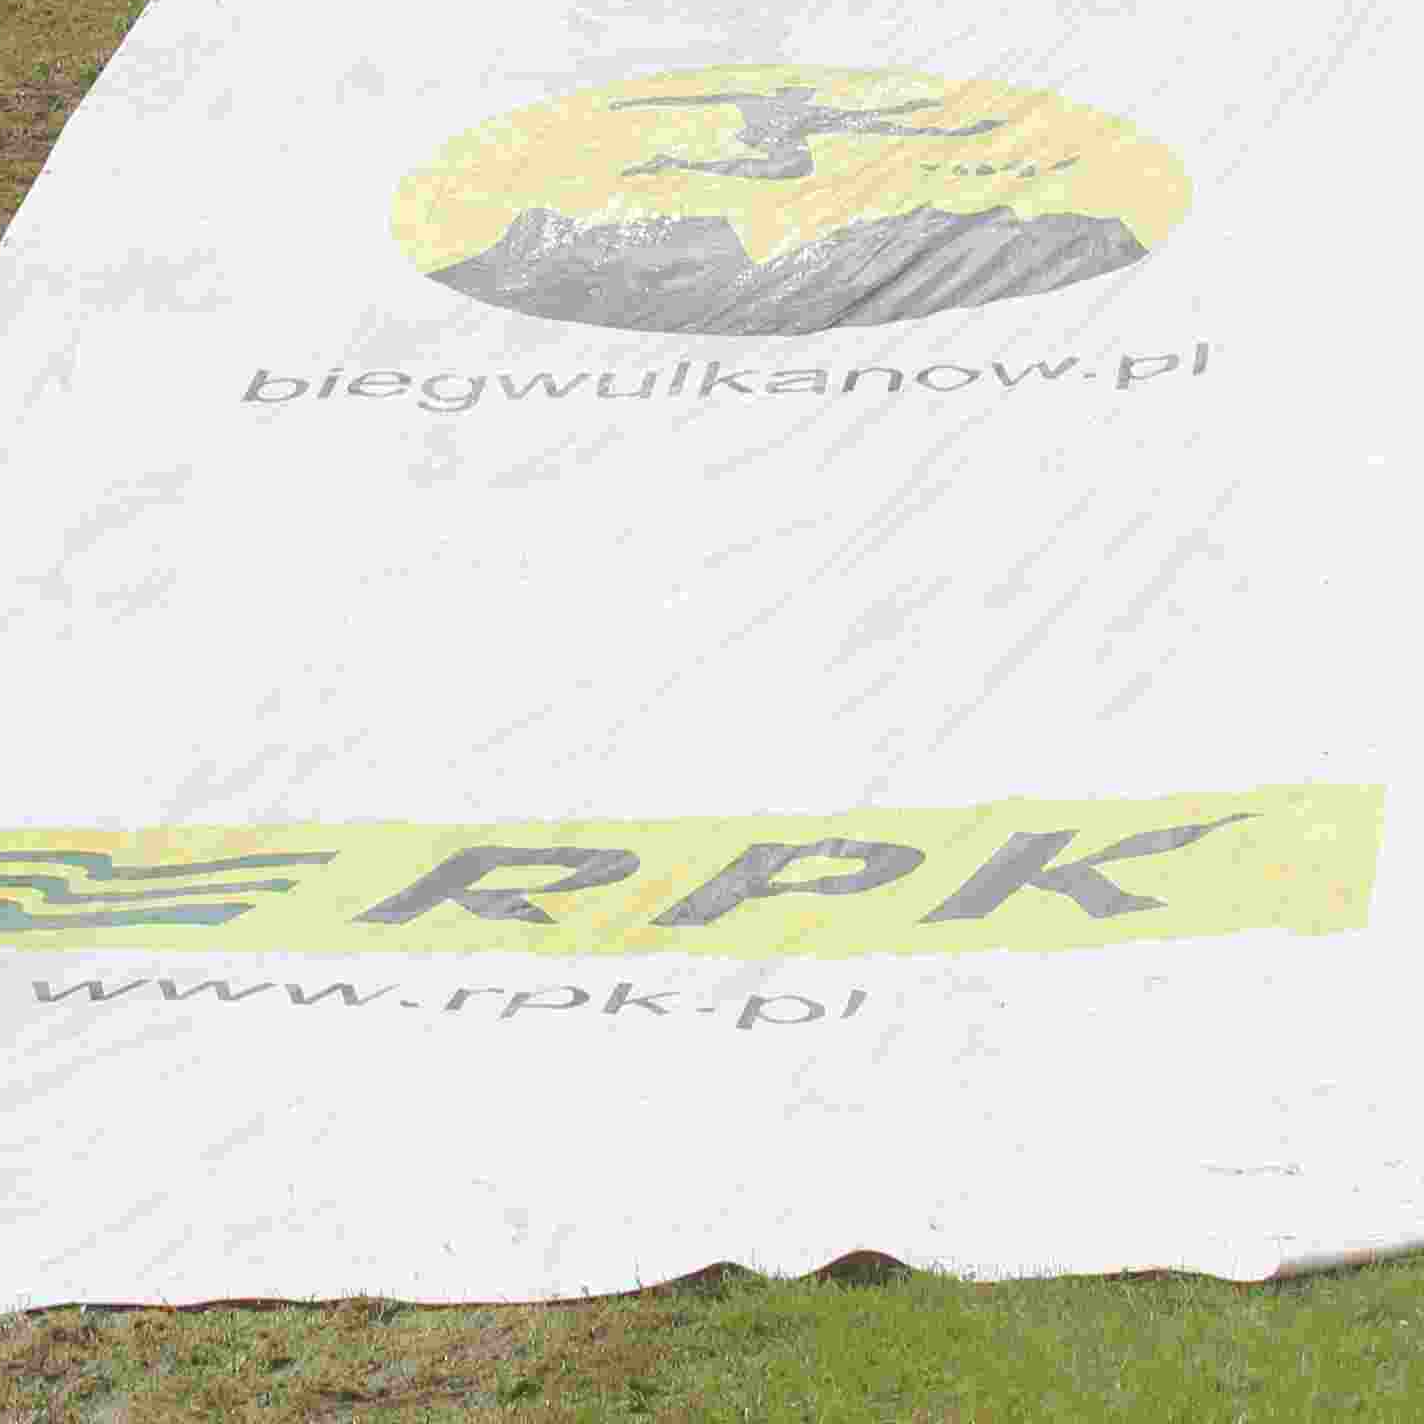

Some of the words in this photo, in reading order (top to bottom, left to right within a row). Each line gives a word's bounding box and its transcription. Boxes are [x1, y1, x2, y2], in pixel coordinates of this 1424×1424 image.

[242, 342, 1211, 413] biegwulkanow.pl
[352, 812, 1266, 927] RPK
[30, 978, 869, 1031] www.rpk.pl
